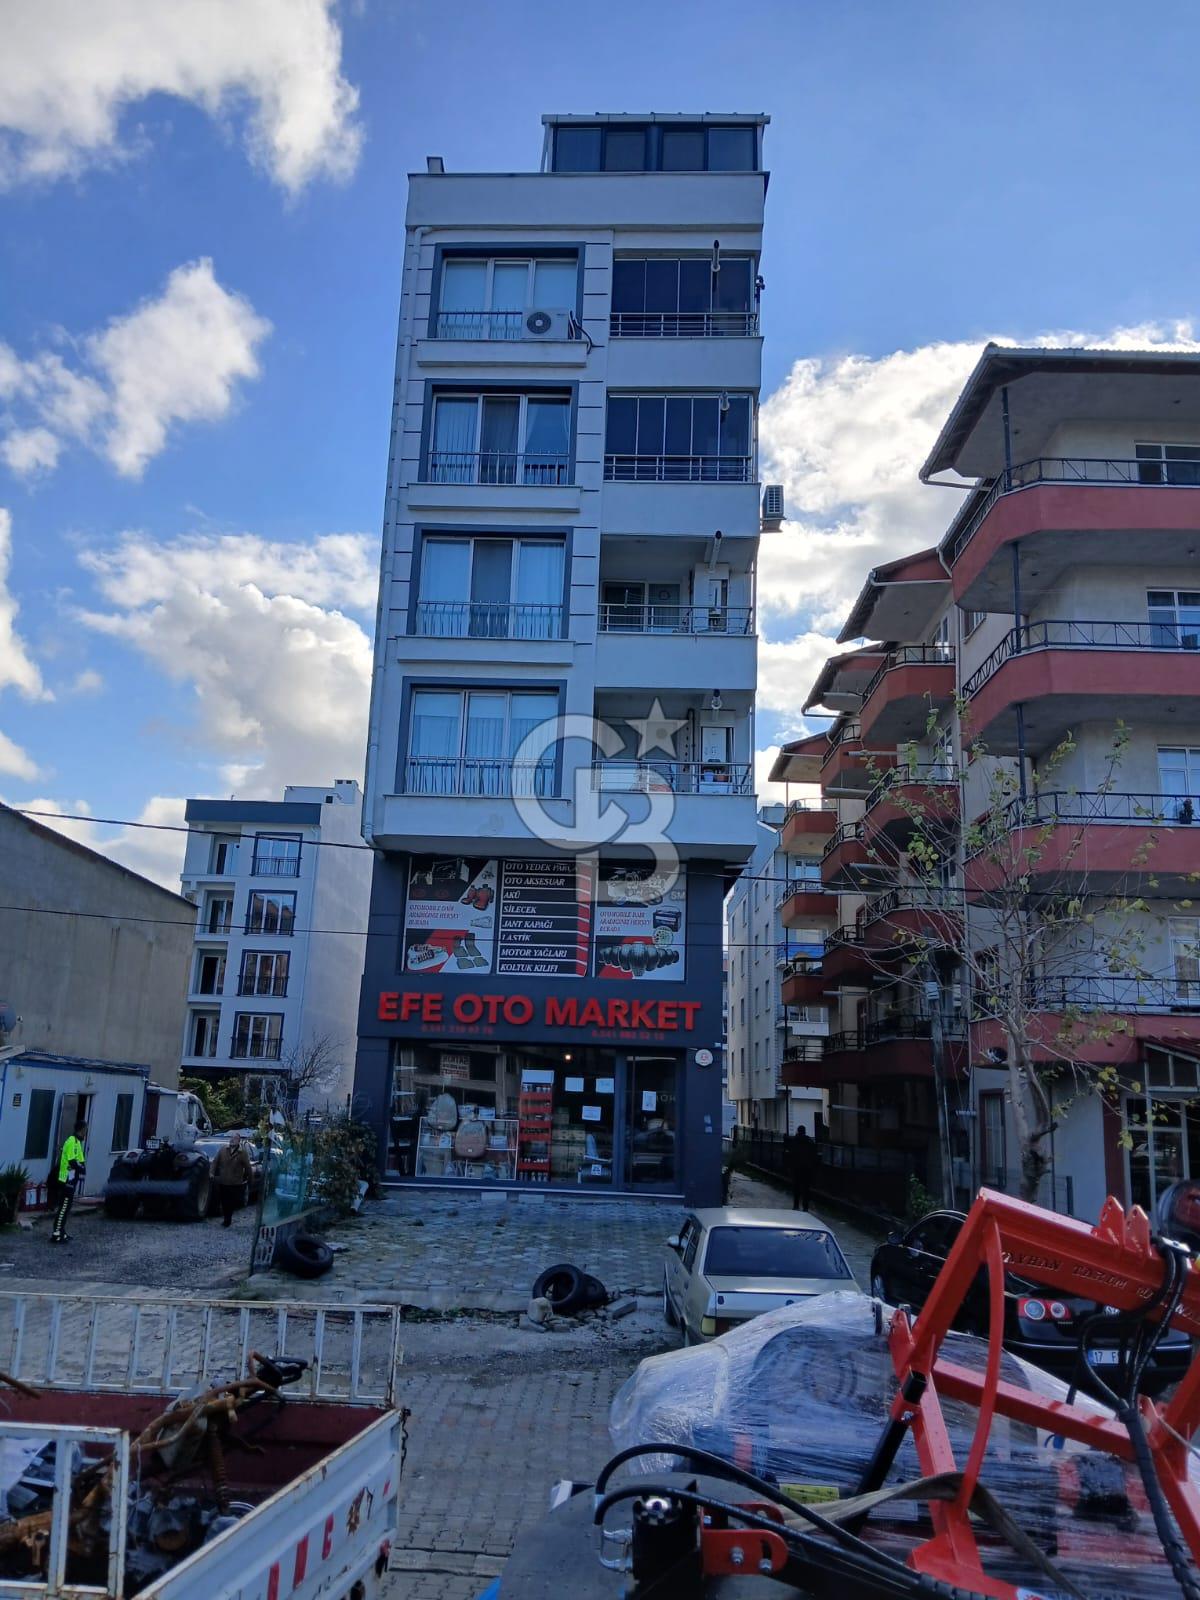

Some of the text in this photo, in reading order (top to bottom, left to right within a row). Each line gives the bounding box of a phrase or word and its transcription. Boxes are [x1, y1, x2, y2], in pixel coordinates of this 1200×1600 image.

[505, 863, 523, 871] OTO
[525, 863, 551, 872] YEDEK
[504, 877, 566, 886] OTO AKSESUAR
[503, 890, 521, 899] AKÜ
[503, 904, 537, 914] SİLECEK
[502, 919, 553, 929] JANT KAPAĞI
[501, 947, 568, 958] MOTOR YAĞLARI
[500, 963, 559, 973] KOLTUK KILIFI
[377, 991, 701, 1031] EFE OTO MARKET
